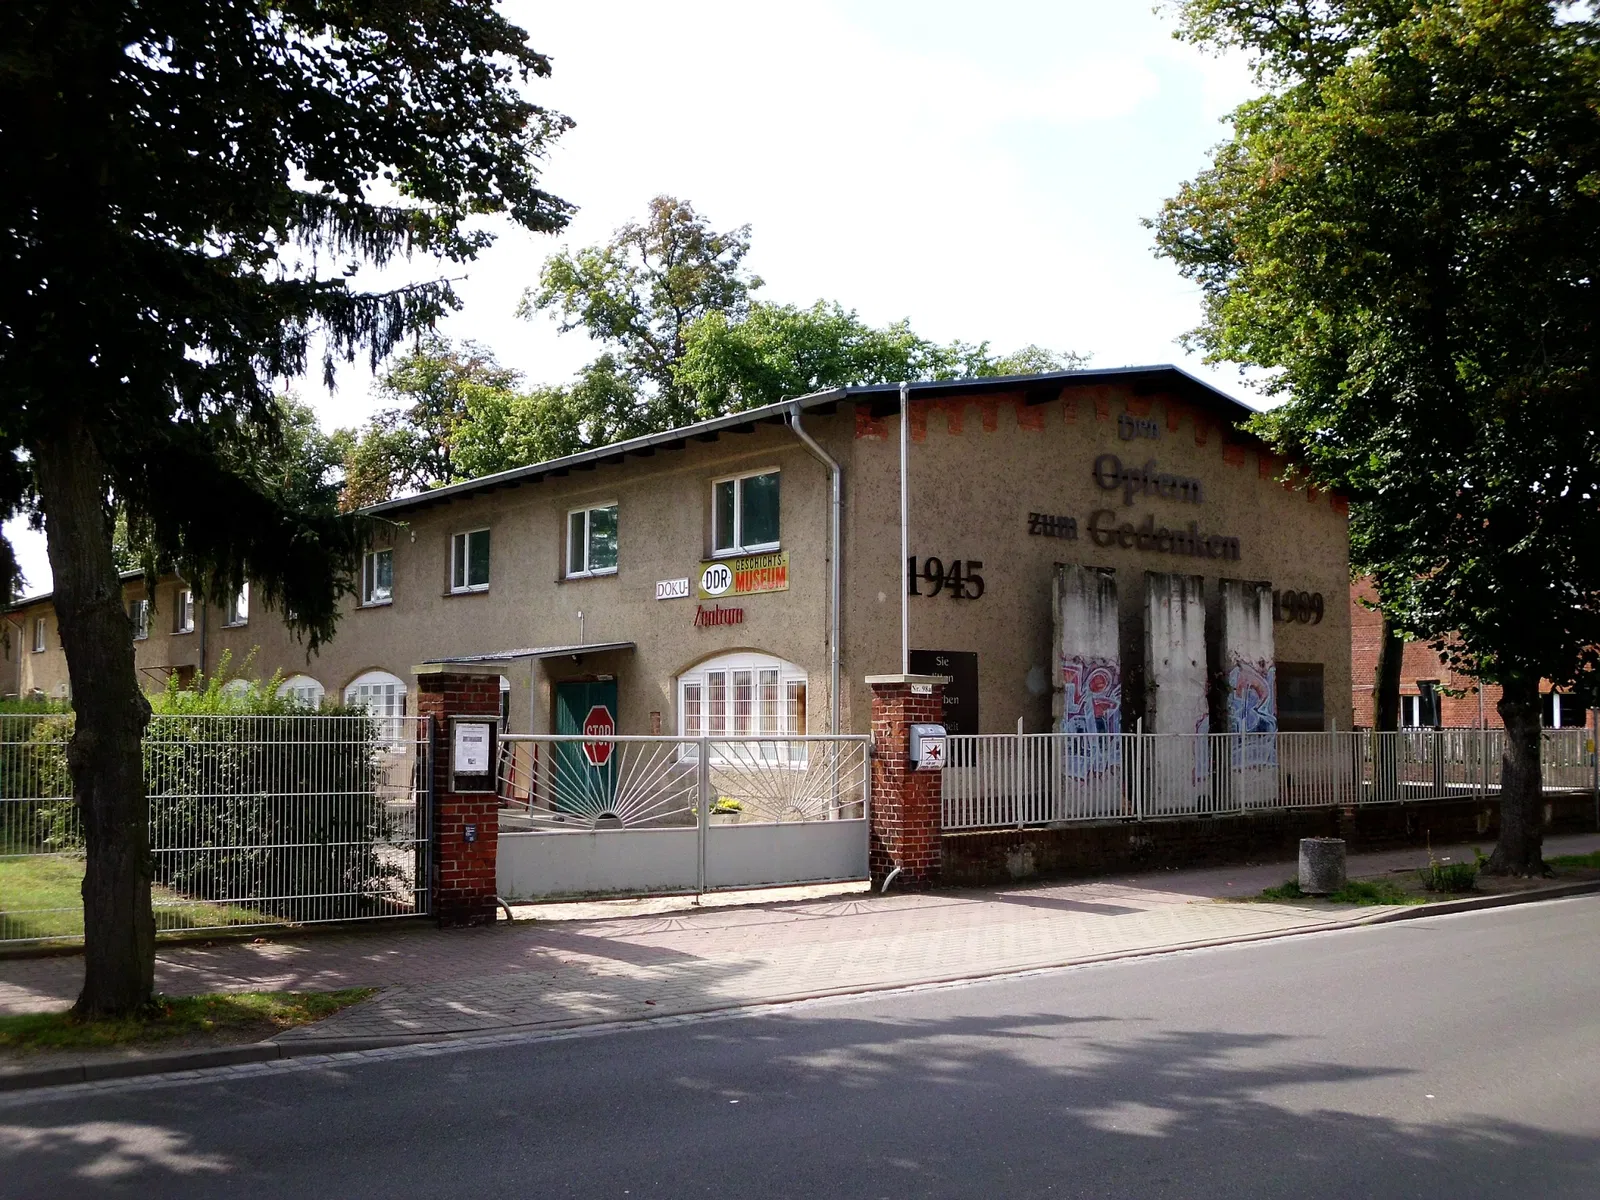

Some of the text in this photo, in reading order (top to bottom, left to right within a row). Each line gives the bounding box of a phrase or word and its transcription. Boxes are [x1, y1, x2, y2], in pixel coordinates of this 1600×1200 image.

[1093, 453, 1203, 505] Opfern
[1028, 508, 1241, 561] zum Gedenken
[735, 554, 786, 571] GESCHICHTS-
[706, 568, 728, 590] DDR
[735, 566, 786, 592] MUSEUM
[908, 555, 985, 600] 1945
[658, 582, 688, 597] DOKU-
[936, 656, 949, 667] Sie
[586, 725, 611, 746] STOP
